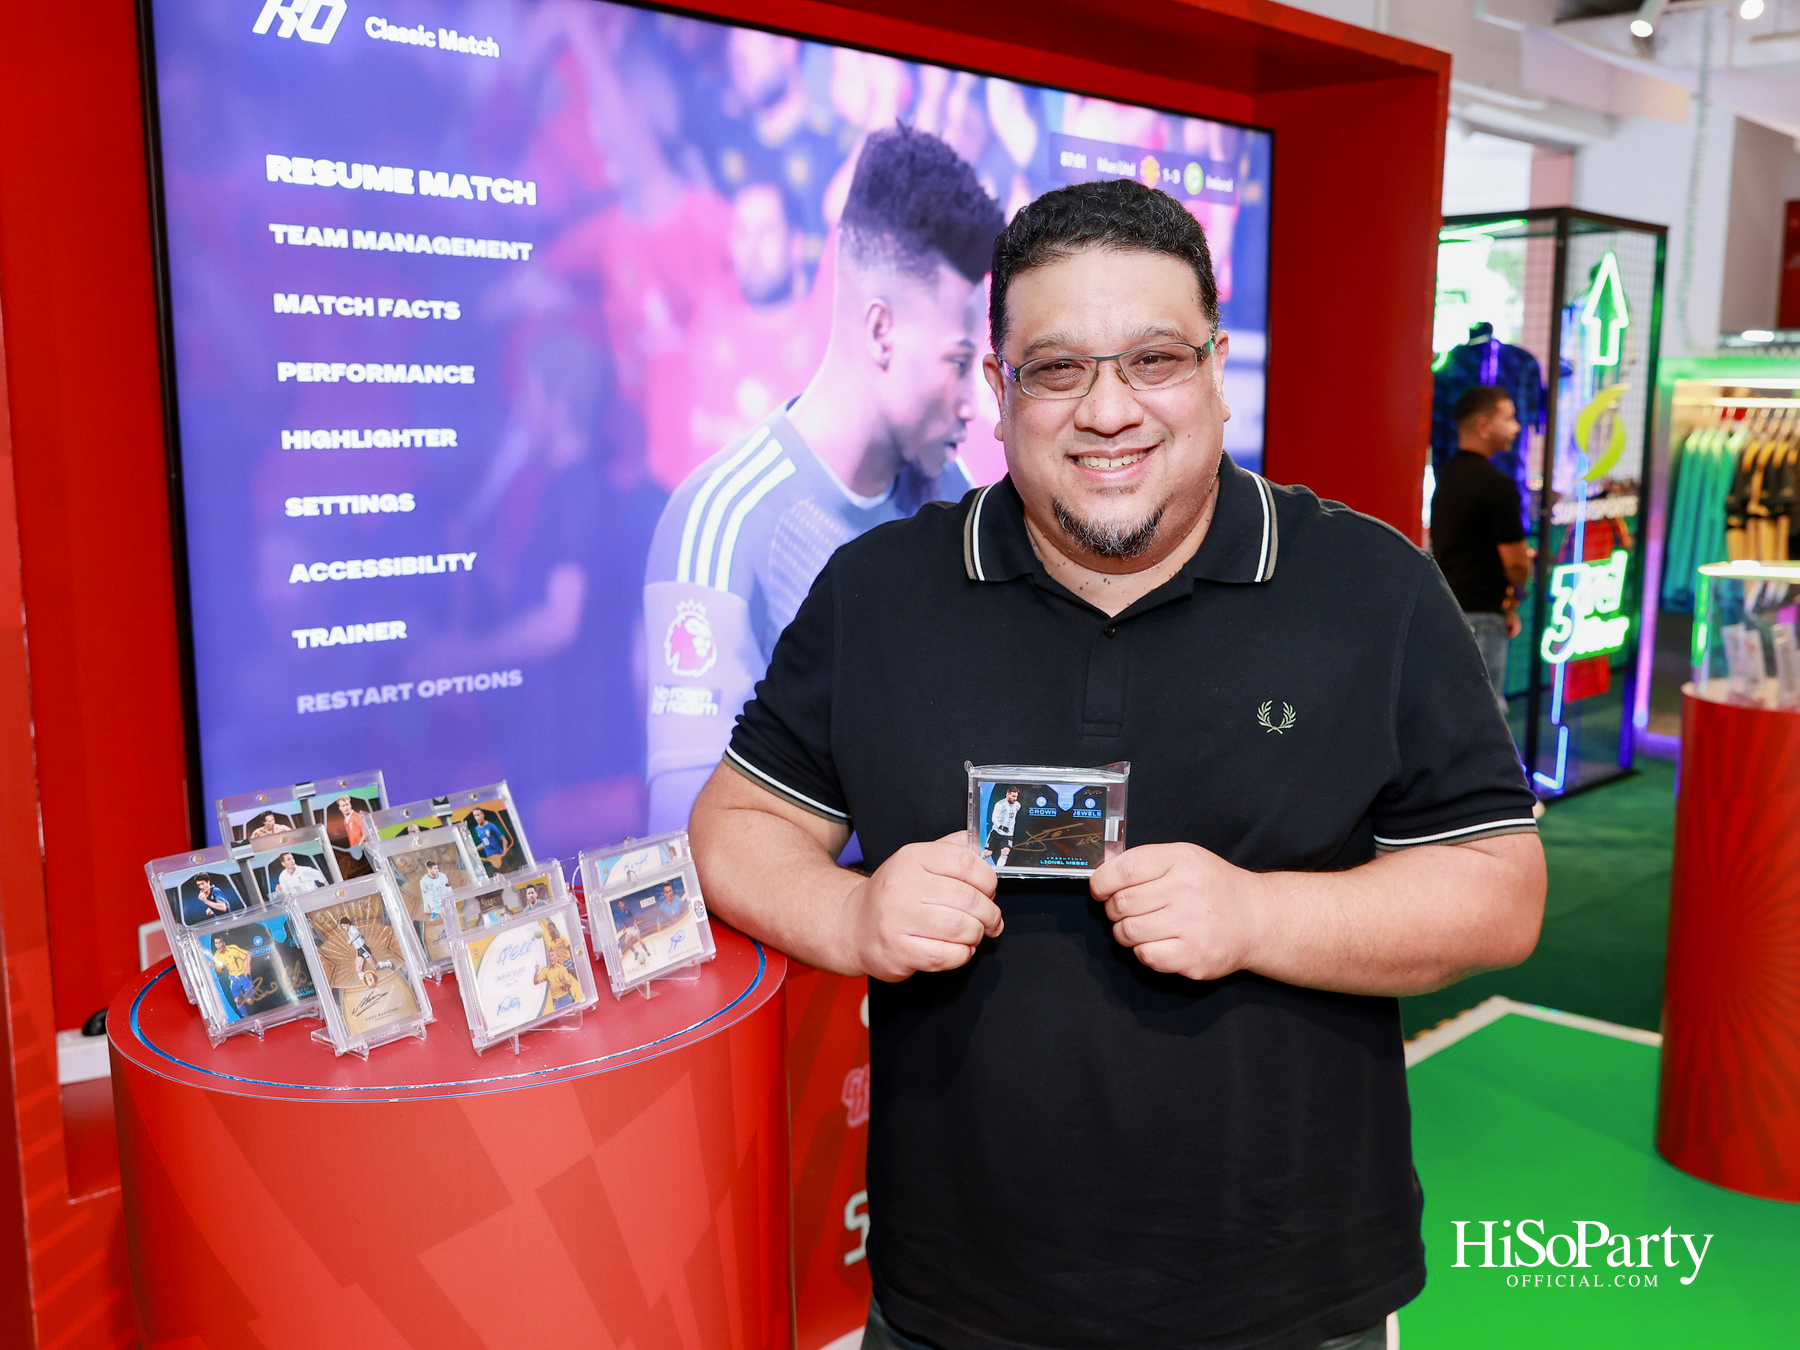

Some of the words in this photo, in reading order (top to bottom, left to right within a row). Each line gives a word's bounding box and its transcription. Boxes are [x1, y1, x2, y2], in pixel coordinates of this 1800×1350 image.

[364, 16, 436, 48] Classic
[438, 28, 500, 58] Match
[265, 154, 415, 194] RESUME
[418, 170, 537, 206] MATCH
[268, 223, 349, 249] TEAM
[352, 229, 534, 261] MANAGEMENT
[273, 293, 374, 317] MATCH
[378, 298, 461, 320] FACTS
[277, 362, 476, 384] PERFORMANCE
[281, 428, 458, 450] HIGHLIGHTER
[284, 493, 416, 517] SETTINGS
[289, 552, 477, 584] ACCESSIBILITY
[292, 620, 407, 649] TRAINER
[297, 682, 414, 714] RESTART
[417, 669, 523, 699] OPTIONS
